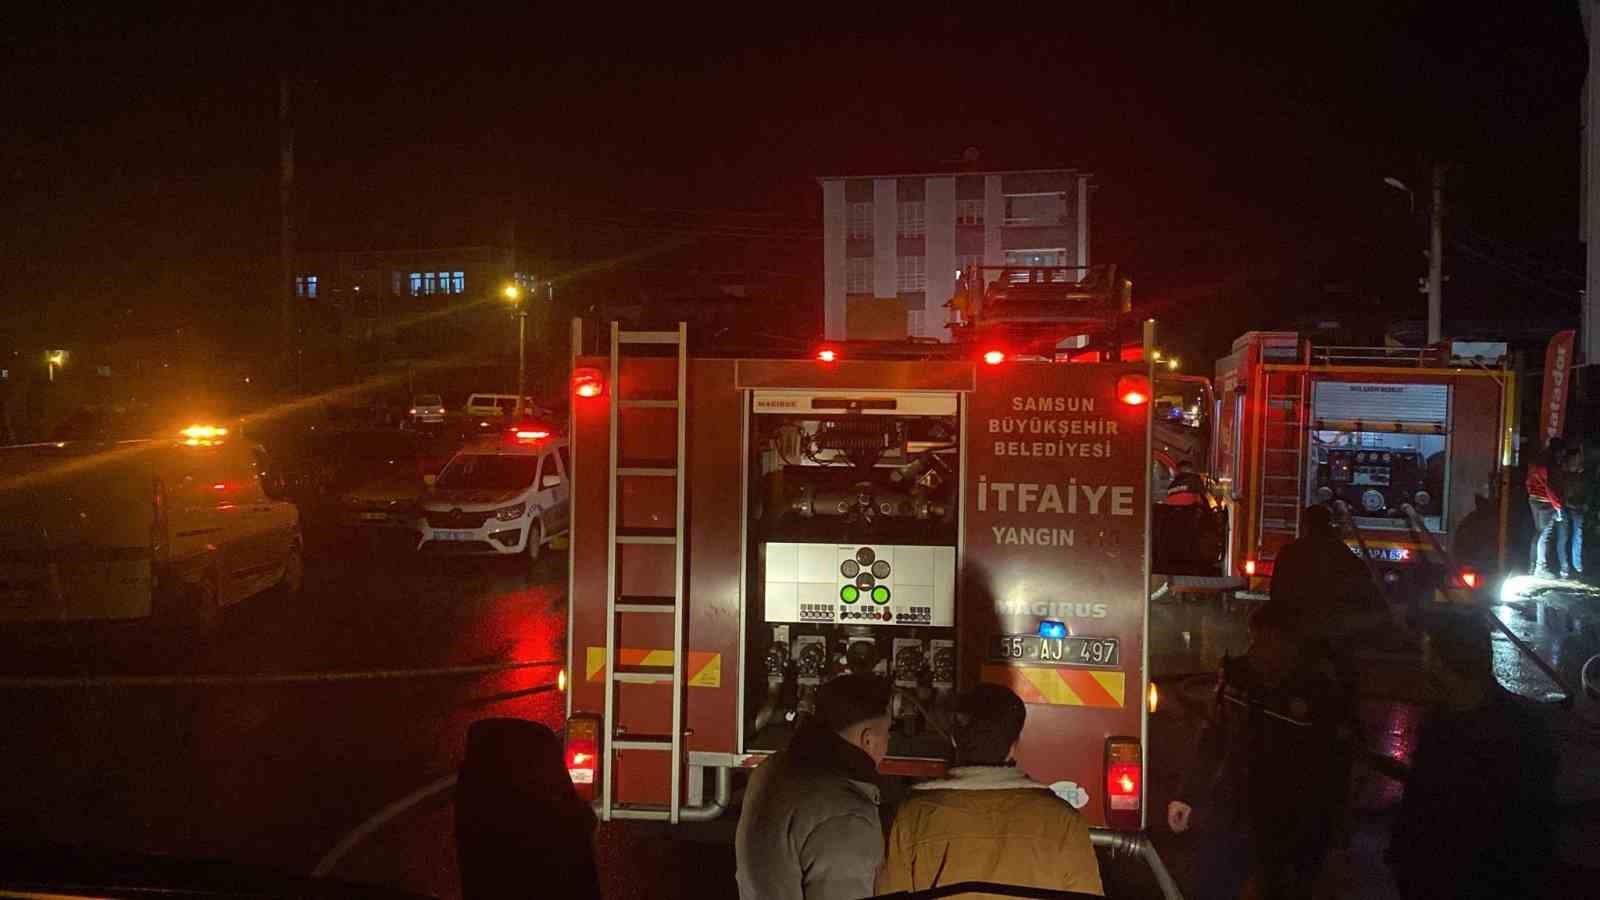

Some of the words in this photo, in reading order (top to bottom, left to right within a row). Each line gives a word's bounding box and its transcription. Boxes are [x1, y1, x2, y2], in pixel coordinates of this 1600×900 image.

[1013, 397, 1094, 411] SAMSUN
[989, 417, 1118, 437] BÜYÜKŞEHİR
[994, 440, 1111, 457] BELEDİYESİ
[977, 475, 1134, 515] İTFAİYE
[992, 526, 1074, 546] YANGIN
[1001, 638, 1023, 657] 55
[1040, 639, 1062, 660] AJ
[1080, 642, 1114, 663] 497
